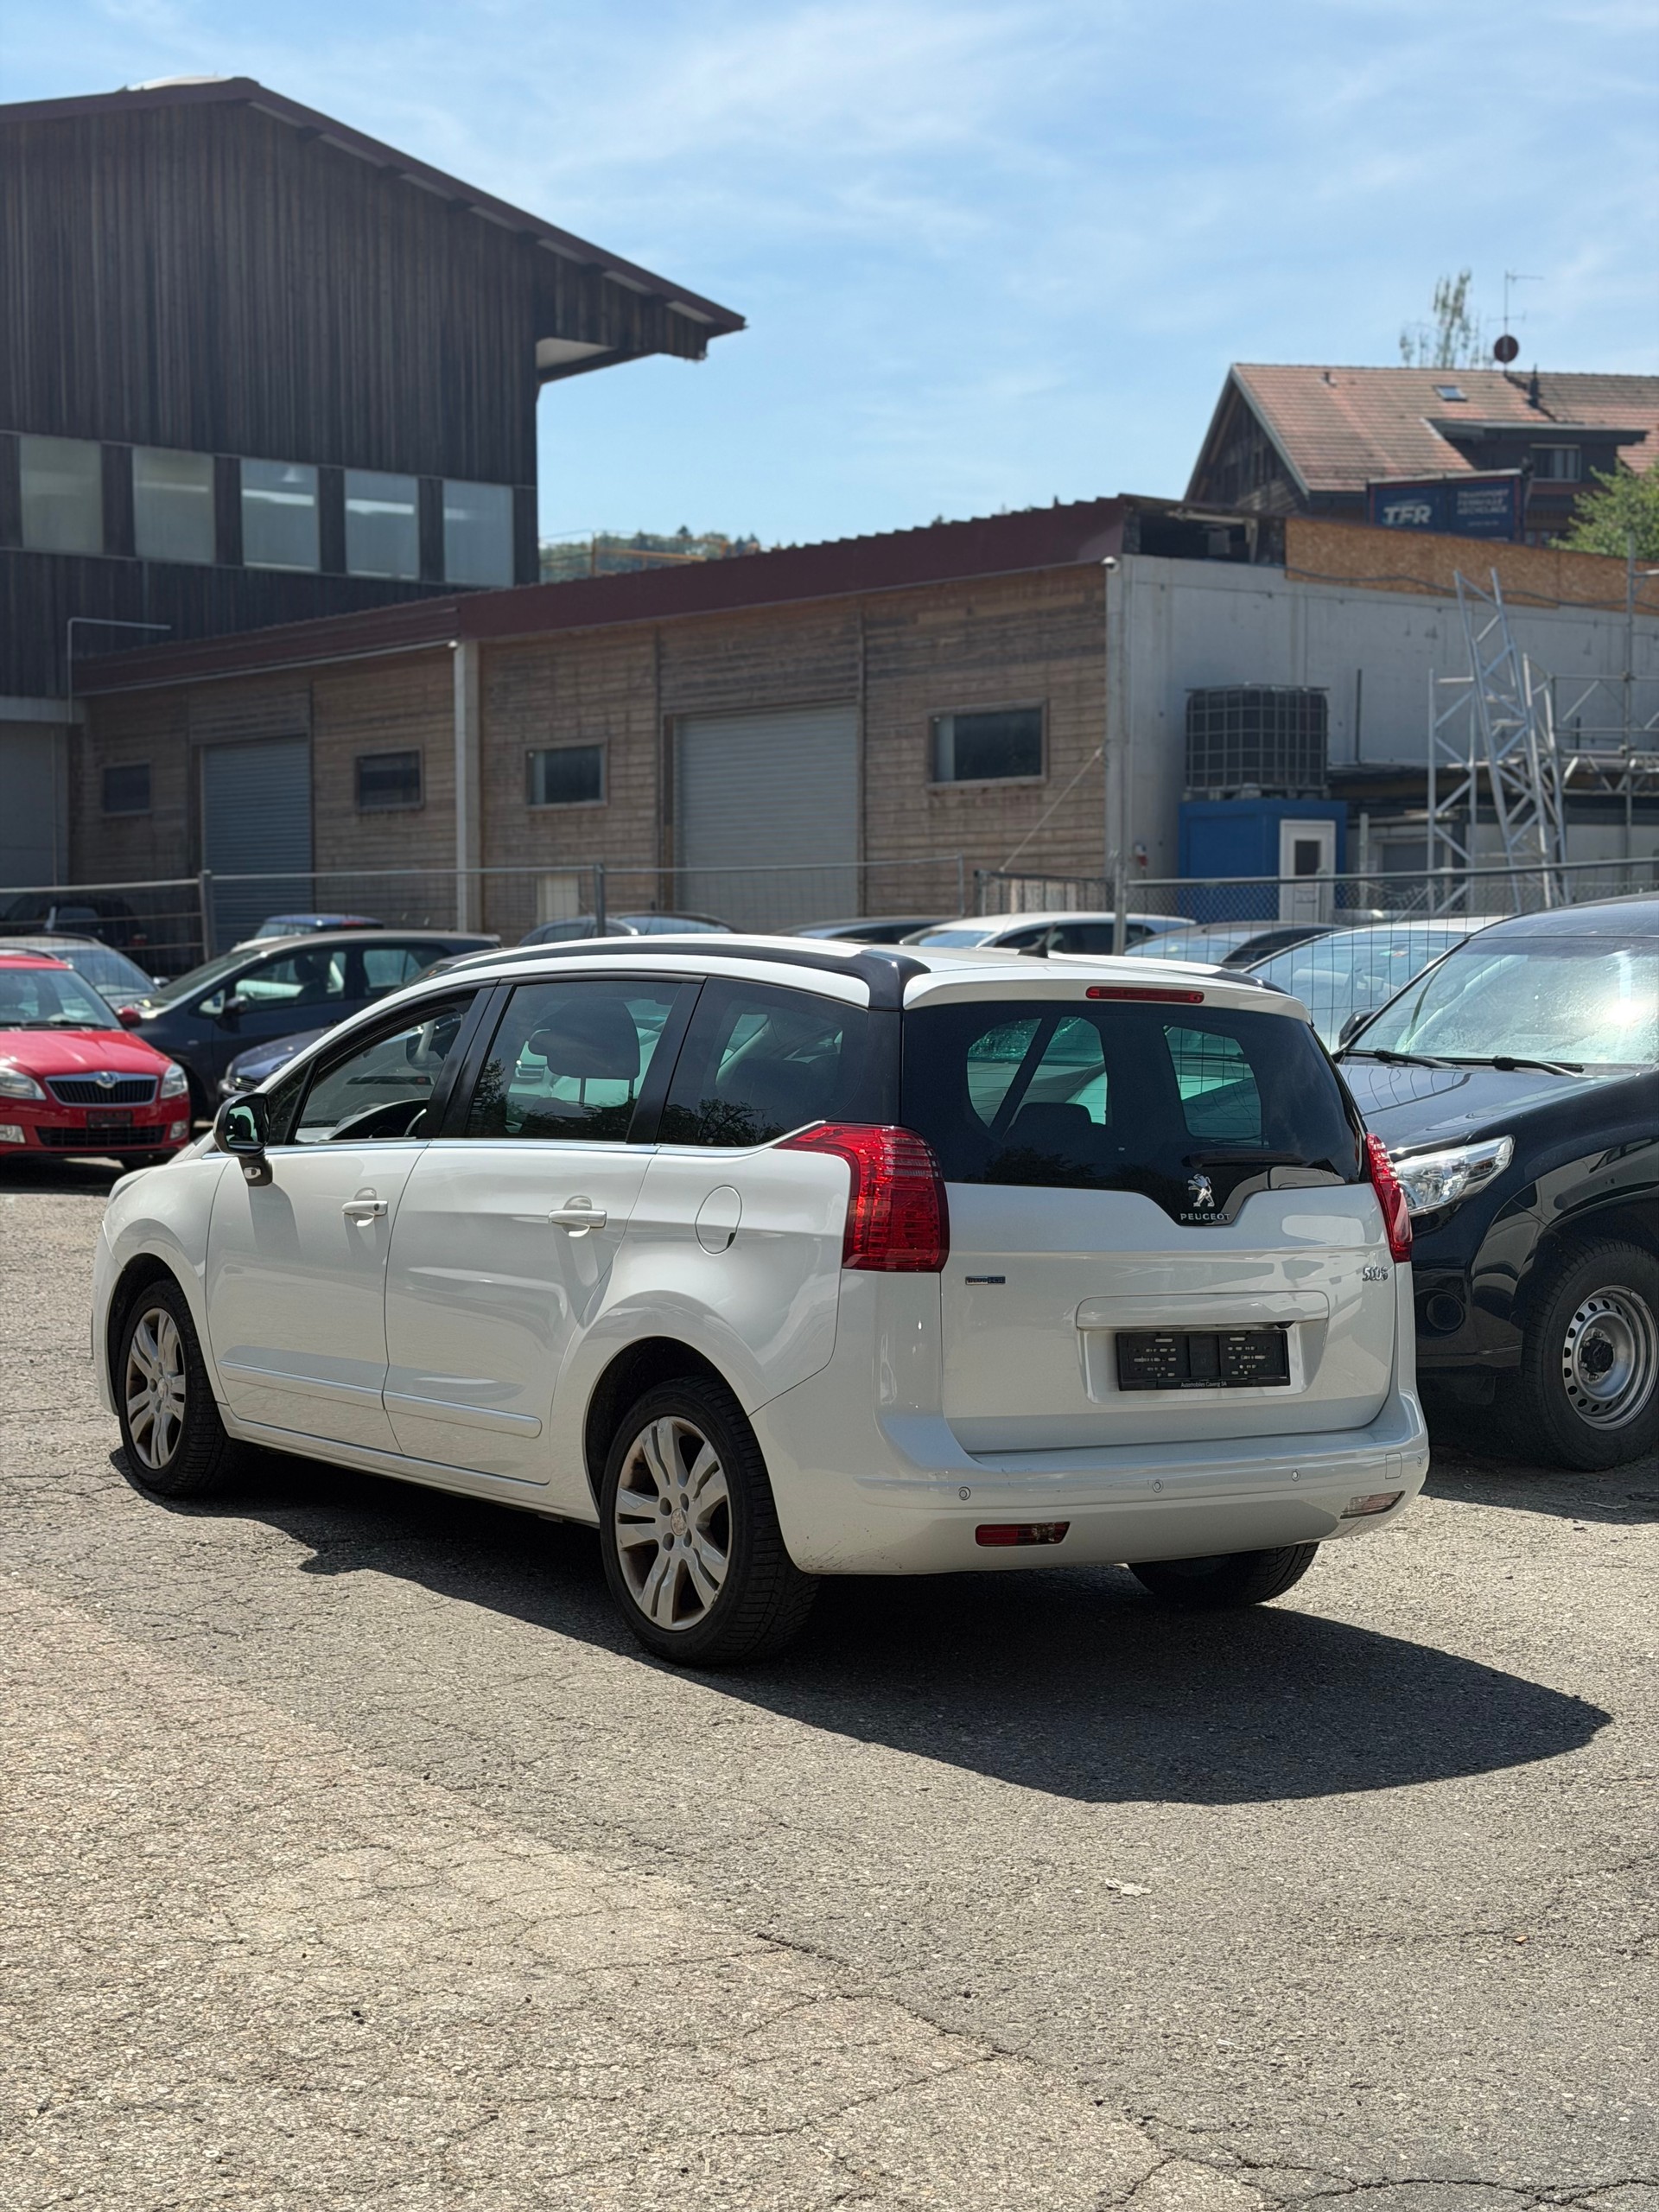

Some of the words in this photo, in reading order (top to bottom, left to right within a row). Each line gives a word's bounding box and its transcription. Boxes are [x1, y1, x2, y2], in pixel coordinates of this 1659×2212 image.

[1382, 505, 1432, 525] TFR
[1179, 1212, 1230, 1221] PEUGEOT
[1362, 1265, 1389, 1281] 5008
